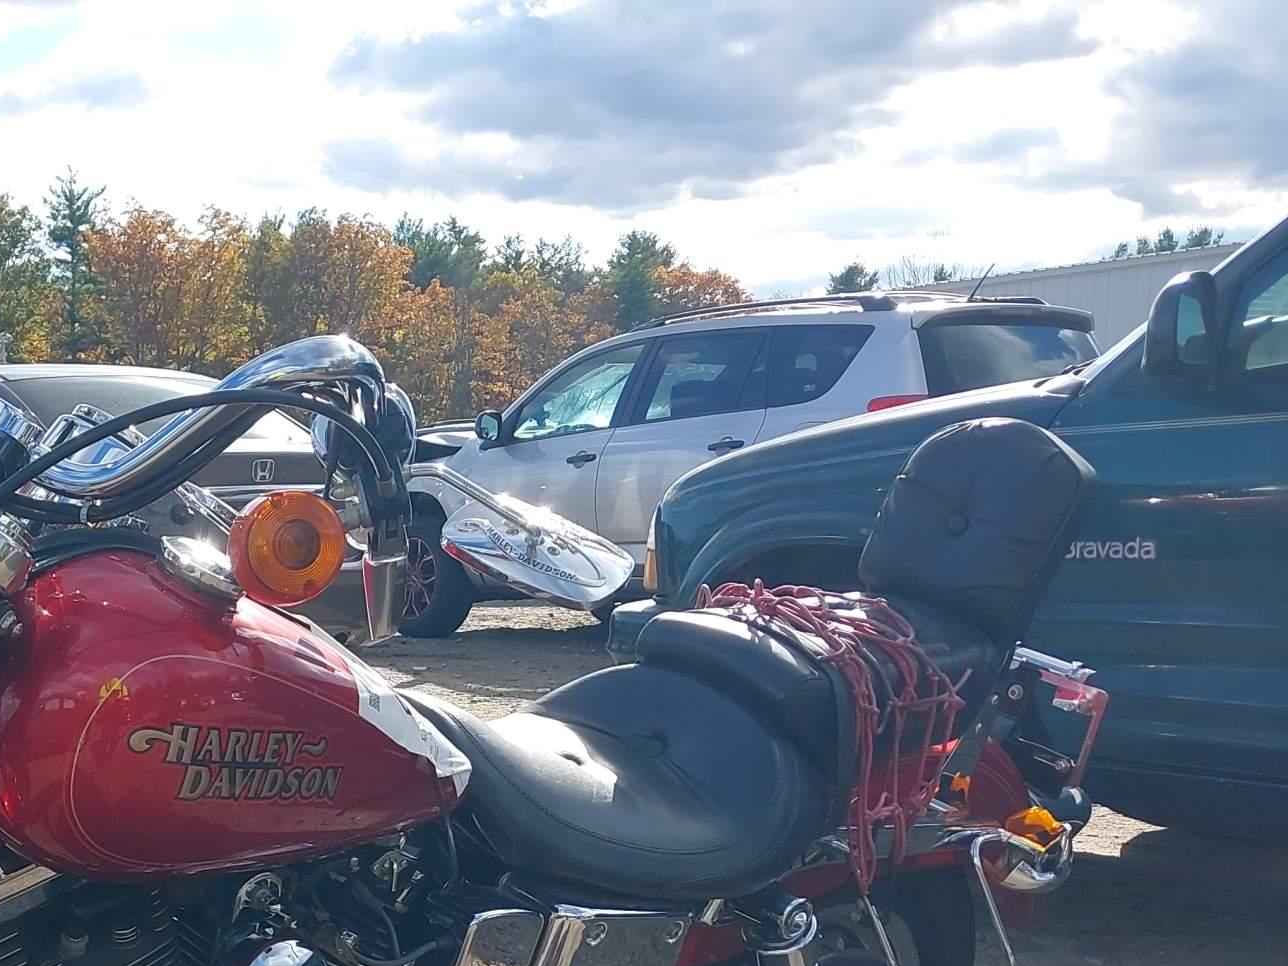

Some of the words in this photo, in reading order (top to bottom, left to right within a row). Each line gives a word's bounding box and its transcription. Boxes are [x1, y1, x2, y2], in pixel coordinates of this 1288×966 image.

[486, 526, 577, 581] HARLEY-DAVIDSON
[129, 723, 304, 766] HARLEY
[176, 764, 343, 801] DAVIDSON
